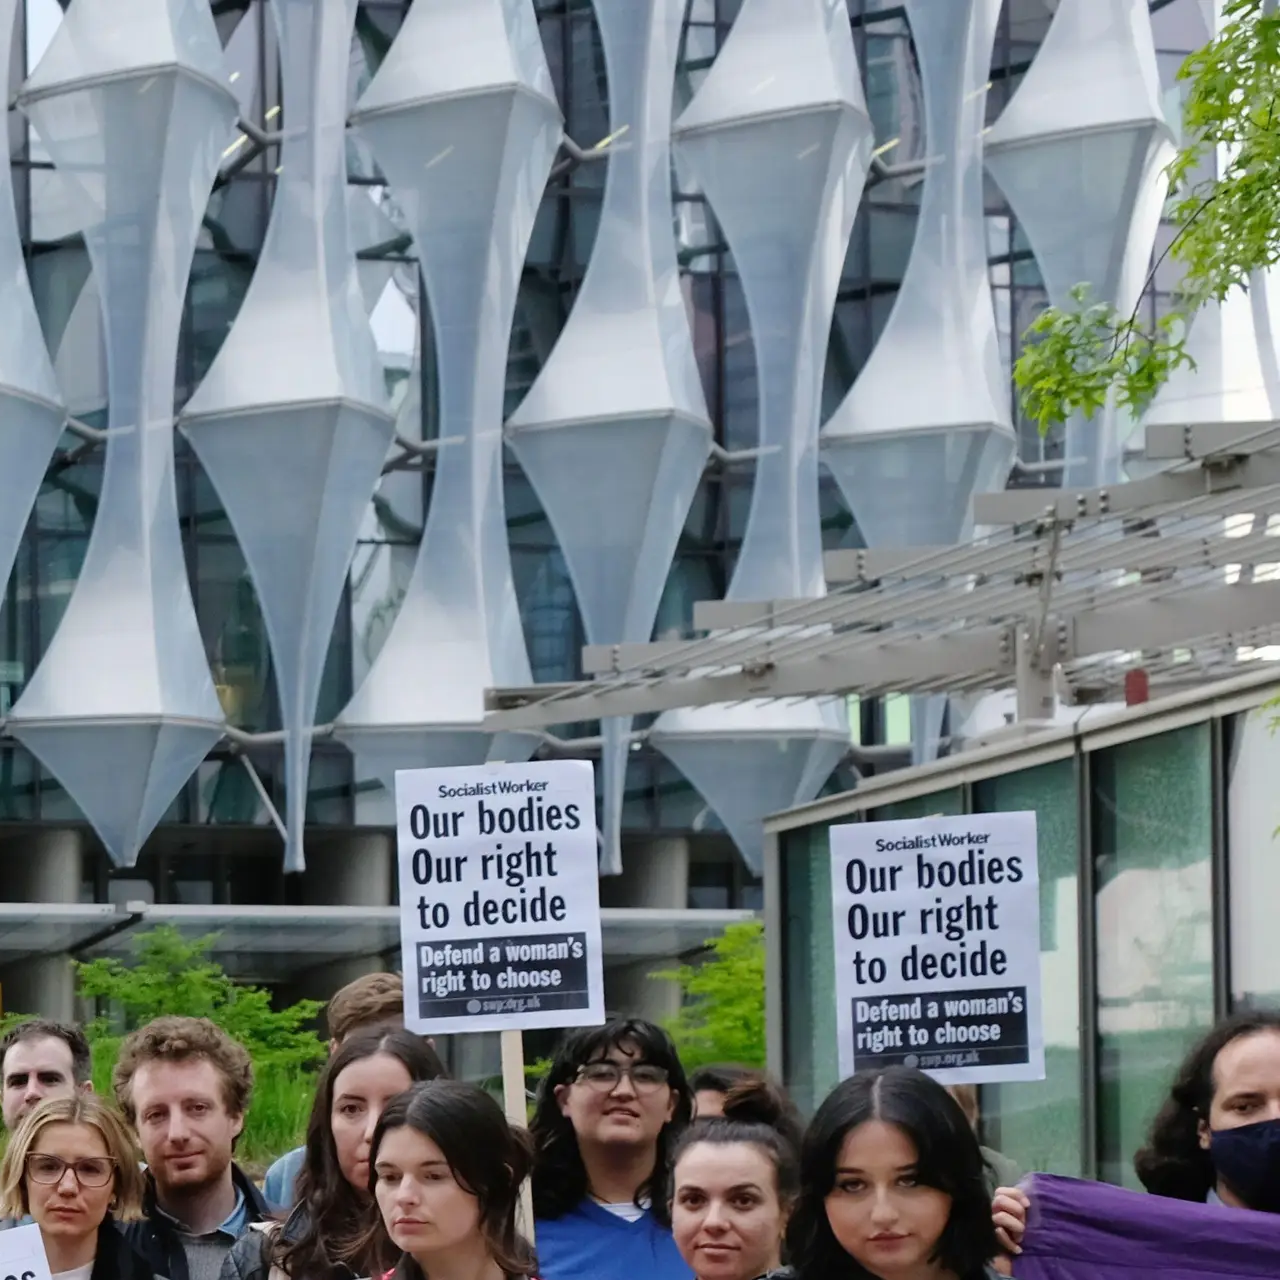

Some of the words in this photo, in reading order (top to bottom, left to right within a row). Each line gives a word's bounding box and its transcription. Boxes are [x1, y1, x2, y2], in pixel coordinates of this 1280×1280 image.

[410, 804, 464, 840] Our
[478, 796, 580, 836] bodies
[412, 848, 467, 885] Our
[481, 841, 558, 888] right
[846, 858, 903, 895] Our
[917, 849, 1023, 890] bodies
[417, 896, 450, 930] to
[464, 886, 566, 927] decide
[848, 903, 906, 940] Our
[920, 895, 999, 941] right
[420, 942, 484, 967] Defend
[490, 948, 500, 963] a
[505, 936, 583, 963] woman's
[853, 951, 887, 985] to
[901, 940, 1007, 981] decide
[422, 970, 466, 998] right
[470, 973, 491, 991] to
[496, 966, 562, 990] choose
[856, 997, 921, 1023] Defend
[927, 1002, 938, 1018] a
[944, 991, 1023, 1017] woman's
[857, 1024, 903, 1053] right
[908, 1025, 929, 1046] to
[935, 1021, 1001, 1043] choose
